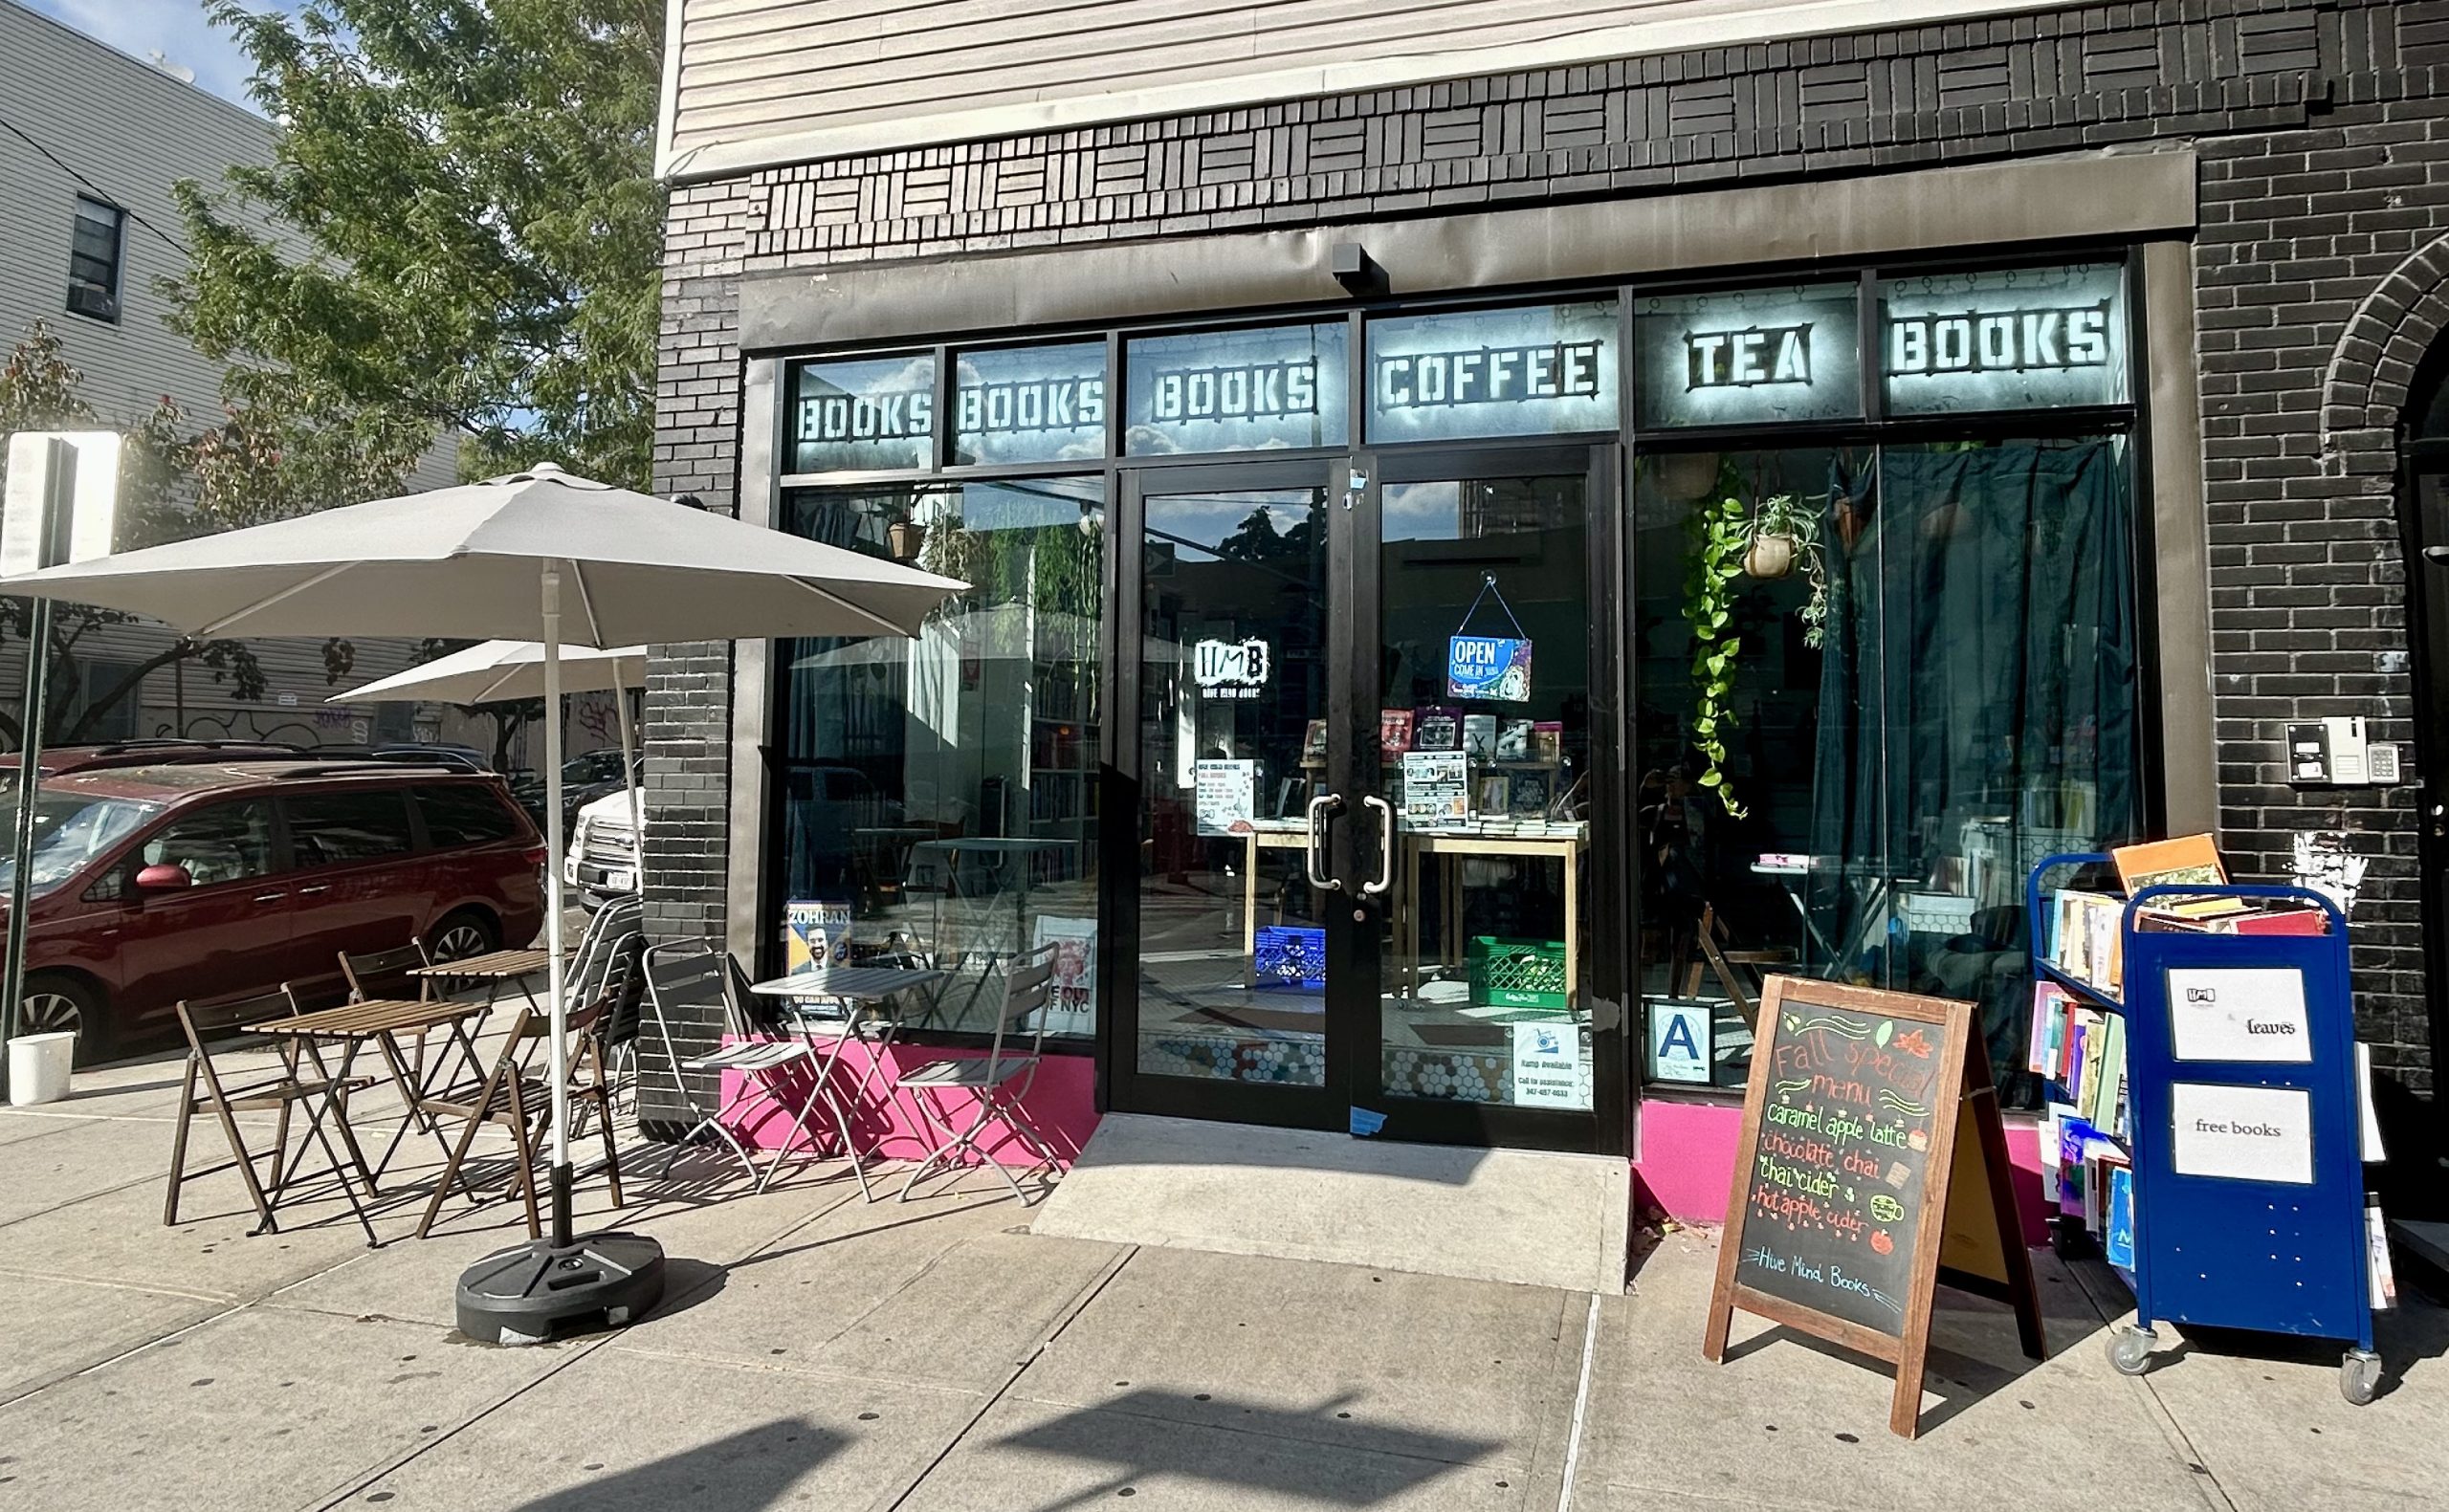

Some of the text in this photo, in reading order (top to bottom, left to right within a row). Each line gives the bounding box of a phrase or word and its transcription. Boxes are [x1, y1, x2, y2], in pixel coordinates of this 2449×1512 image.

[1692, 327, 1806, 383] TEA
[1892, 308, 2106, 372] BOOKS
[1158, 366, 1313, 417] BOOKS
[1380, 347, 1595, 403] COFFEE
[798, 397, 932, 439] BOOKS
[959, 381, 1103, 430] BOOKS
[1201, 646, 1263, 679] HMB
[1454, 640, 1496, 665] OPEN
[1454, 664, 1474, 675] COME
[787, 909, 851, 925] ZOHRAN
[1061, 999, 1090, 1013] NYC
[2245, 1018, 2296, 1035] leaves
[1659, 1014, 1700, 1060] A
[1775, 1029, 1835, 1078] Fall
[1811, 1074, 1872, 1108] menu
[1767, 1103, 1908, 1150] caramel apple latte
[2195, 1118, 2282, 1137] free books
[1760, 1156, 1840, 1199] chai cider
[1764, 1130, 1881, 1179] chocolate chai
[1756, 1185, 1869, 1233] hot apple cider
[1758, 1245, 1870, 1297] Hive Mind Books
